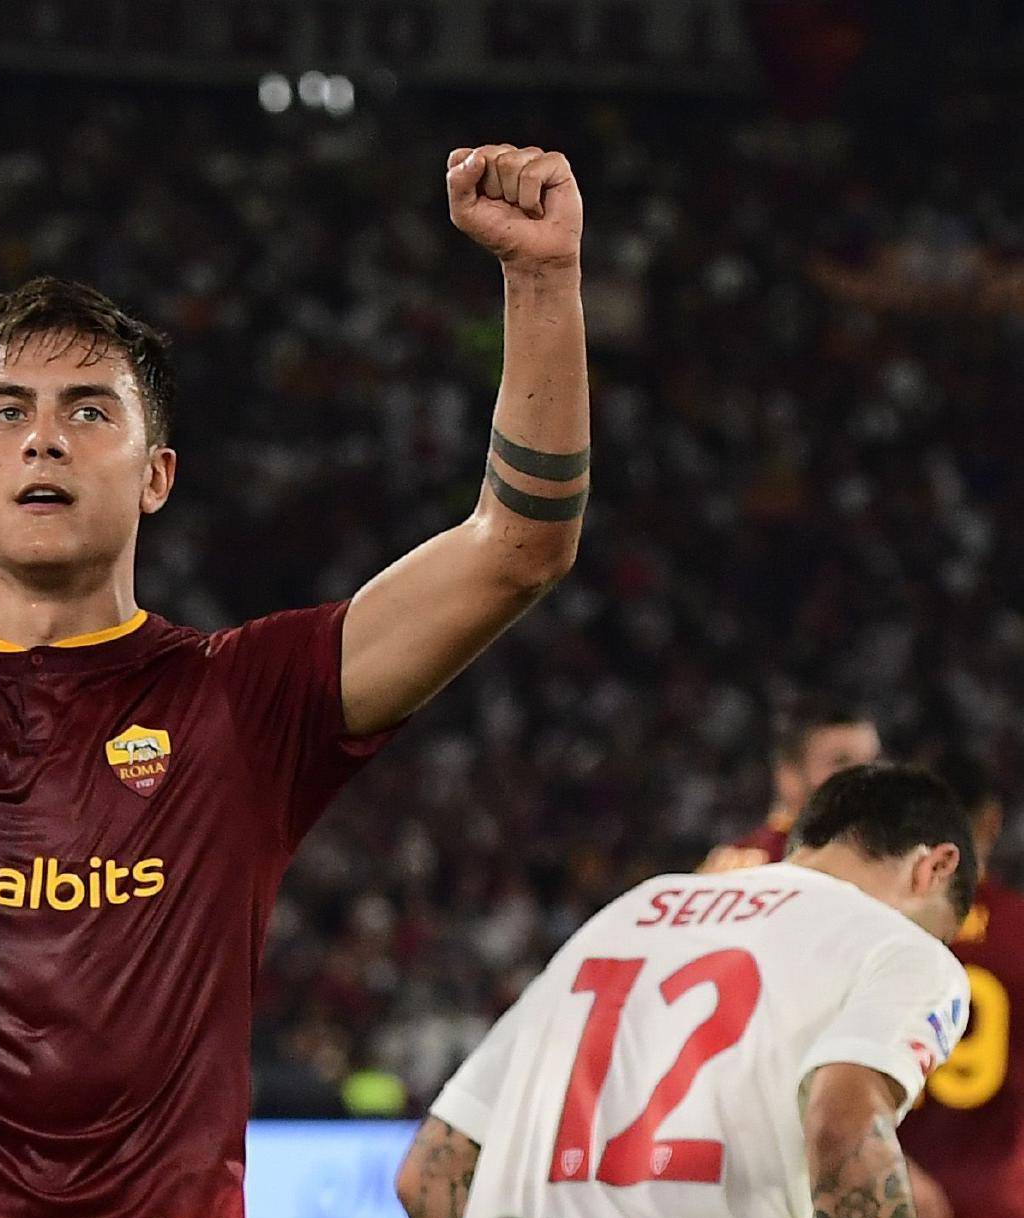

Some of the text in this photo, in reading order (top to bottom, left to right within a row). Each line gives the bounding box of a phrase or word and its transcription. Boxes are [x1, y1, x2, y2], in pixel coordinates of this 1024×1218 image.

[120, 762, 166, 780] ROMA
[636, 889, 800, 926] SENSI
[548, 948, 763, 1187] 12
